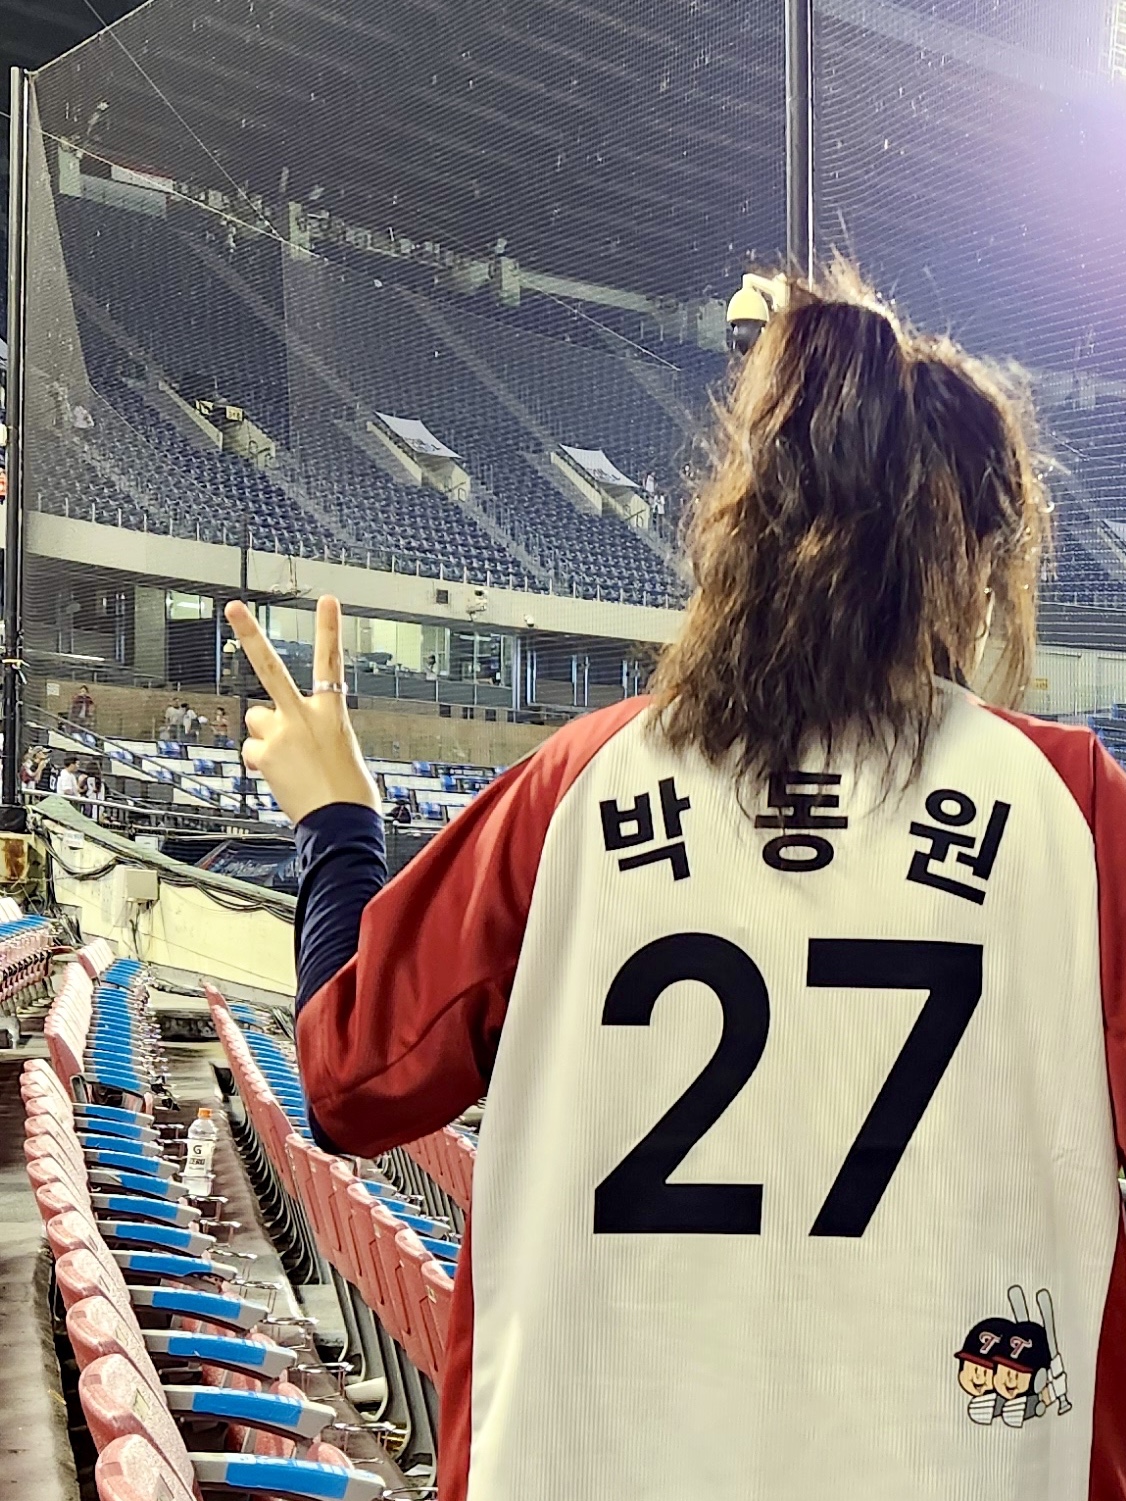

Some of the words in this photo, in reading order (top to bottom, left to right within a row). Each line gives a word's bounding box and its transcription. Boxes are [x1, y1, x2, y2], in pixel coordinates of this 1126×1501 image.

[593, 932, 984, 1238] 27
[193, 1144, 203, 1155] G
[979, 1331, 1001, 1355] T
[1009, 1335, 1033, 1359] T
